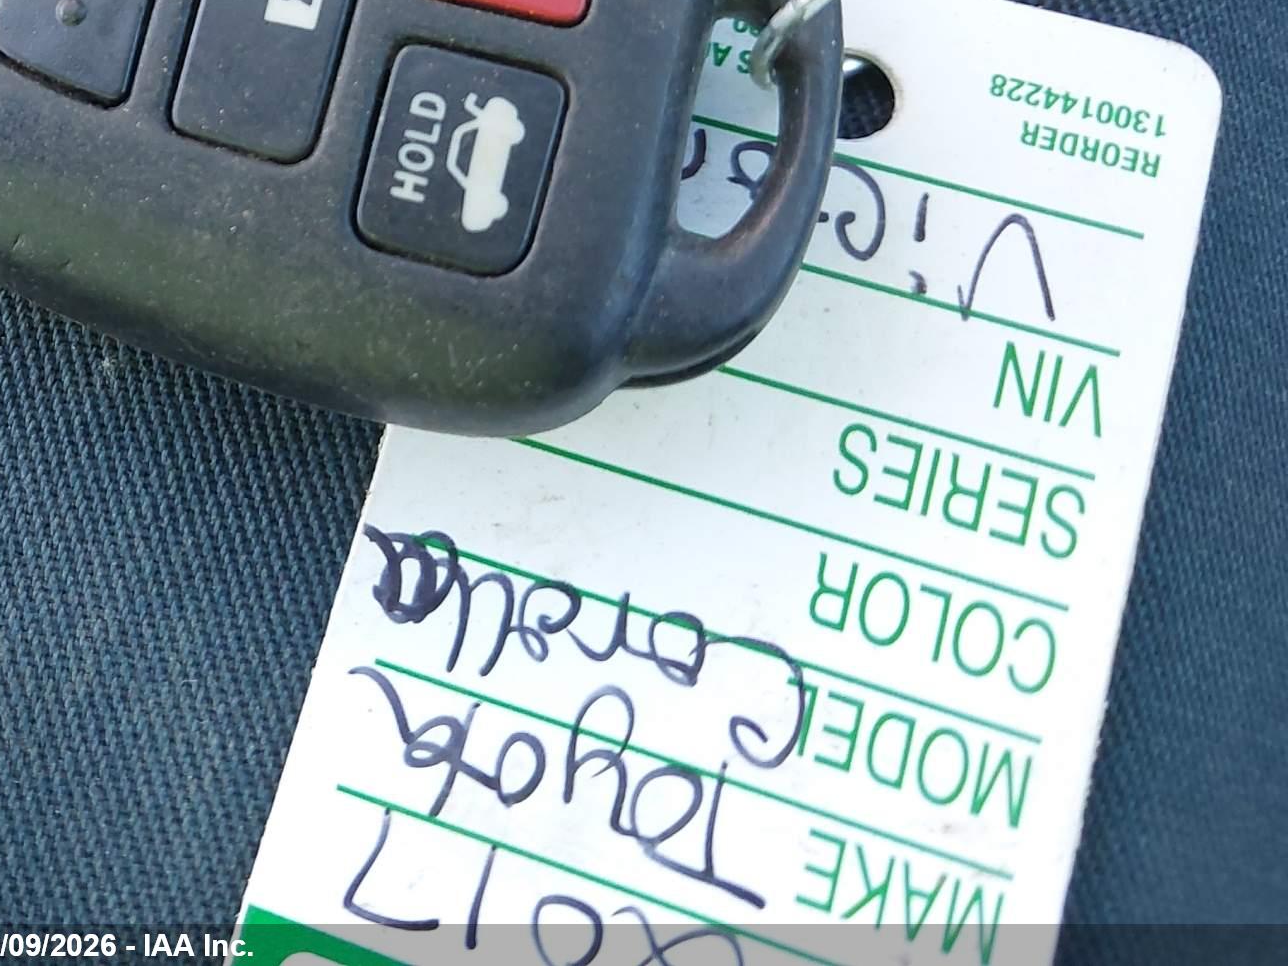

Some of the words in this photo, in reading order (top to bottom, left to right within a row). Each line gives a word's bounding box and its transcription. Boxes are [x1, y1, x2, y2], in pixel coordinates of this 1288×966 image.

[390, 90, 448, 203] HOLD
[989, 74, 1166, 138] 1300144228
[1020, 119, 1161, 178] REORDER
[994, 341, 1104, 437] VIN
[832, 423, 1088, 560] SERIES
[363, 523, 807, 770] Corolla
[809, 552, 1057, 696] COLOR
[347, 666, 766, 910] Toyota
[786, 677, 1033, 828] MODEL
[795, 829, 1006, 965] MAKE
